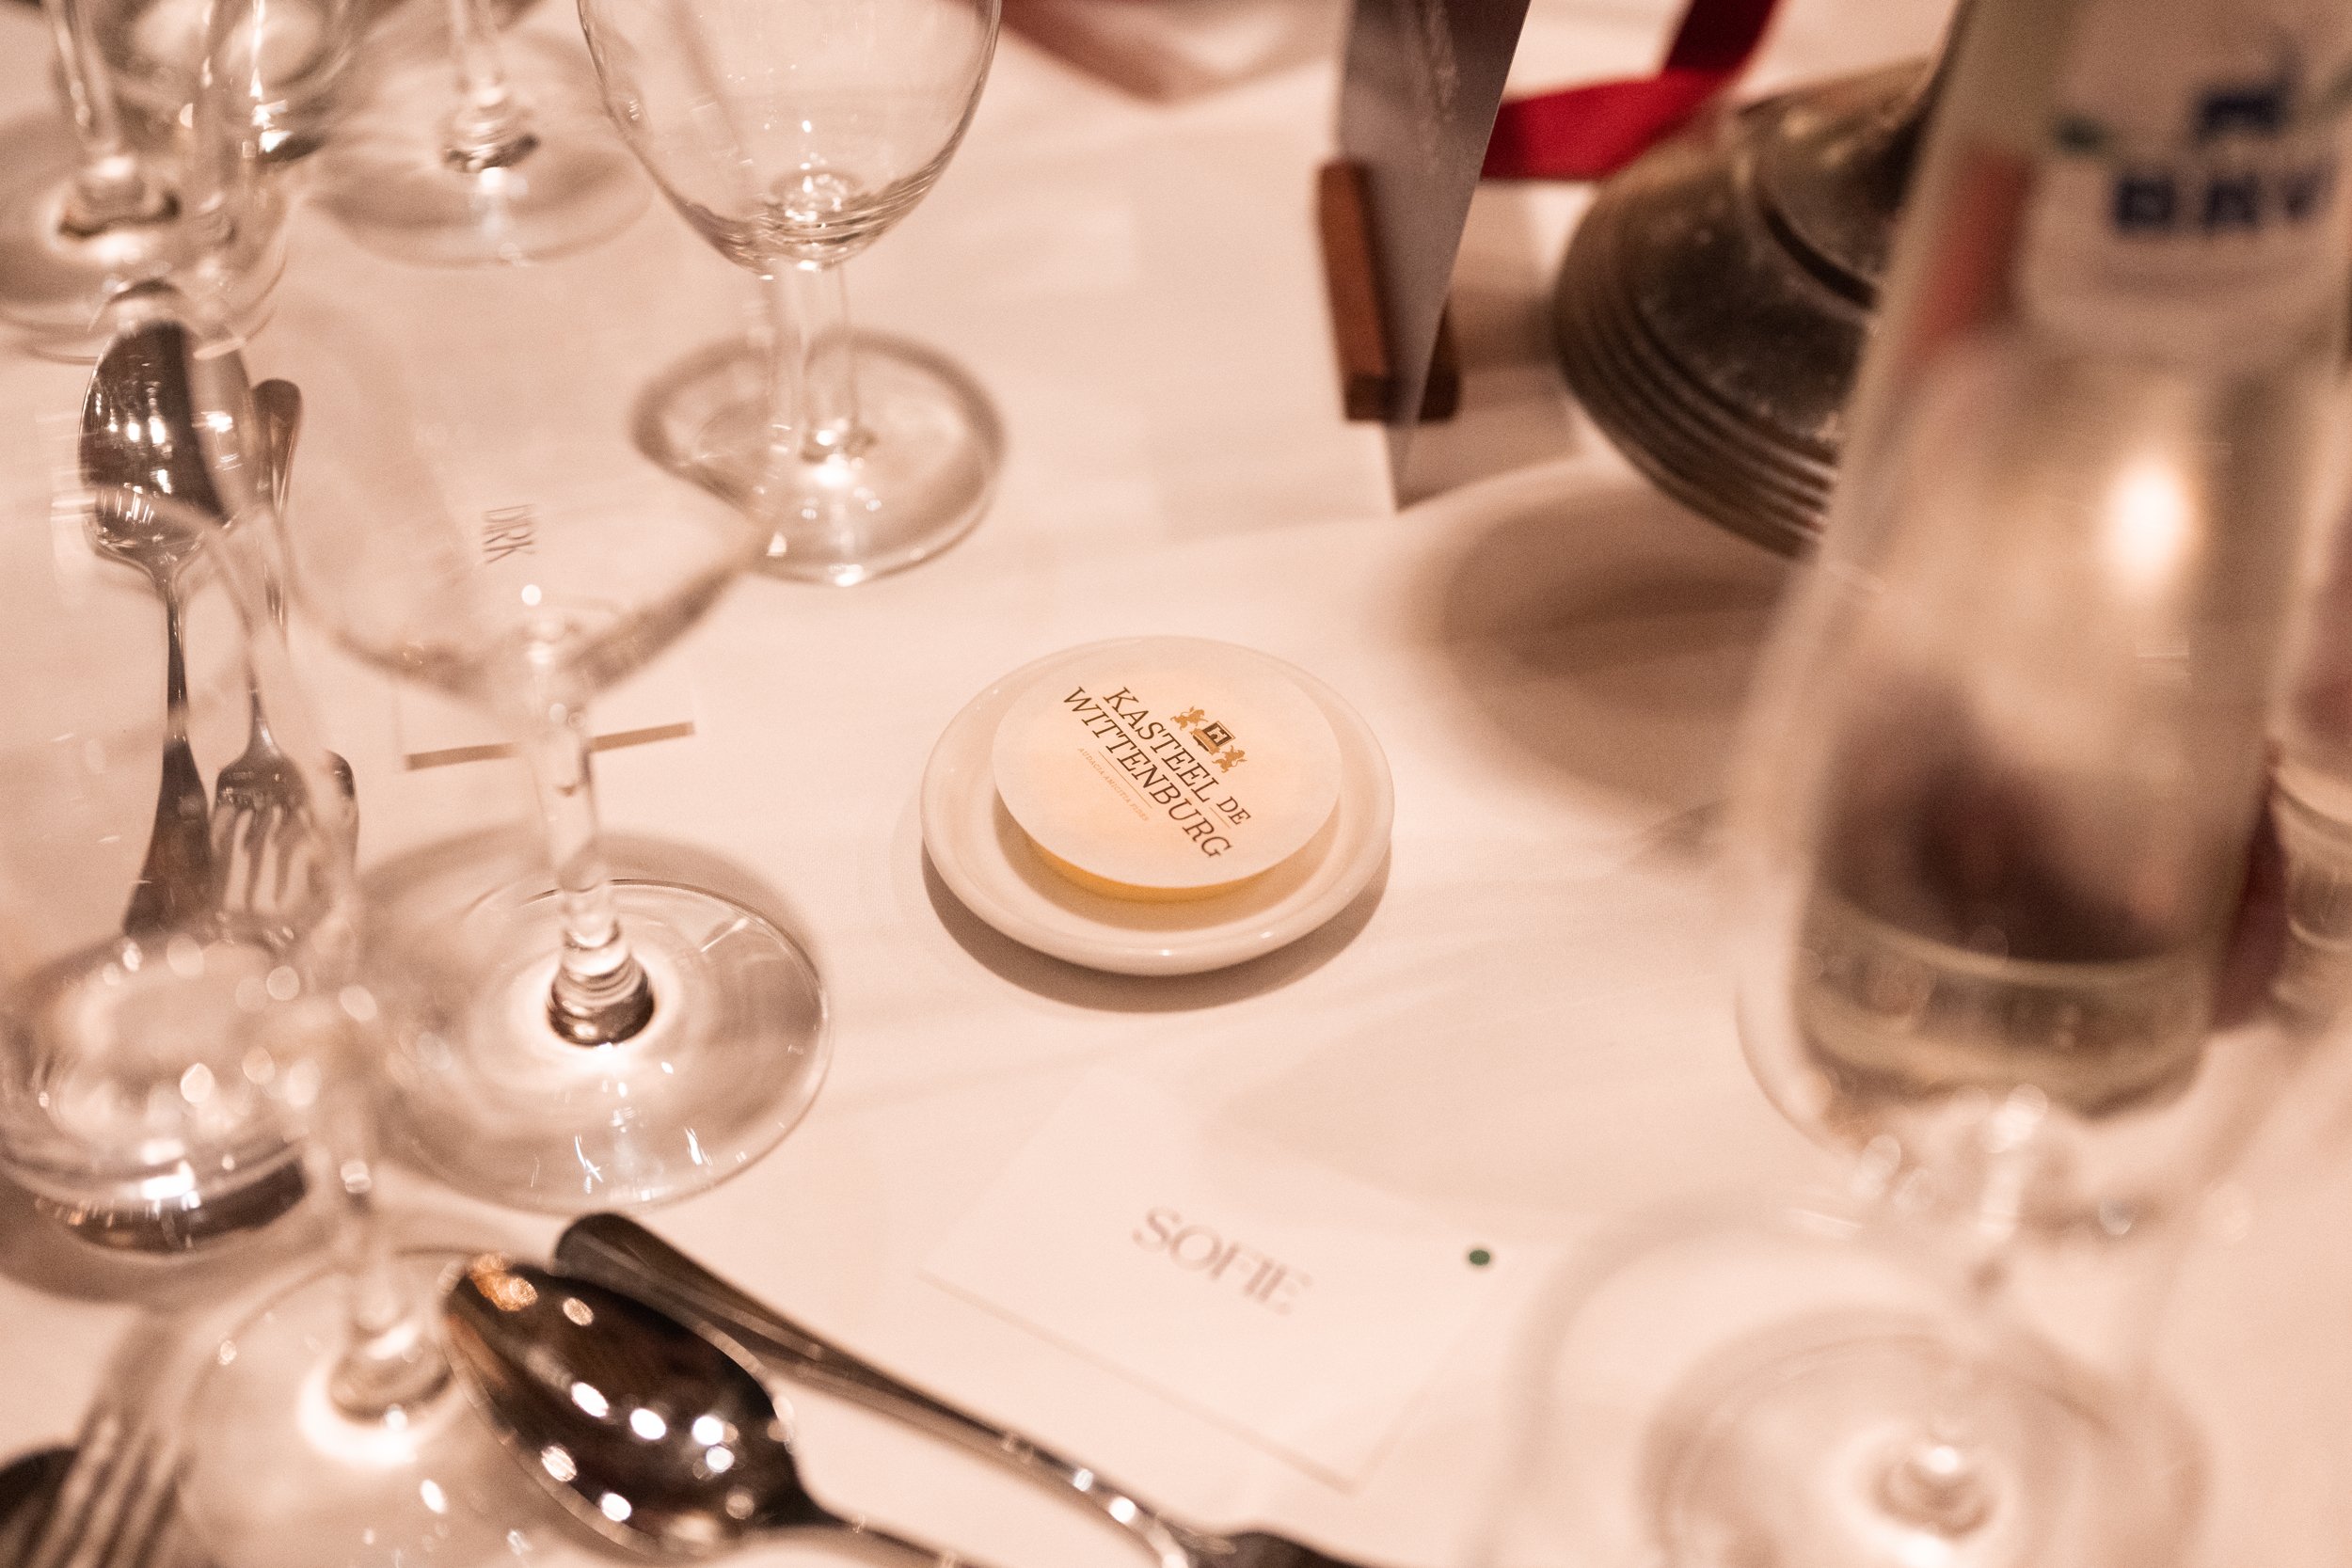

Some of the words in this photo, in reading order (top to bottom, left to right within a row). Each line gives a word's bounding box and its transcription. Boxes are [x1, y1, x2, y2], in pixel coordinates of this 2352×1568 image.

[1063, 686, 1234, 857] WITTENBURG
[1103, 687, 1219, 802] KASTEEL
[1216, 796, 1251, 825] DE
[1131, 1206, 1313, 1316] SOFIE
